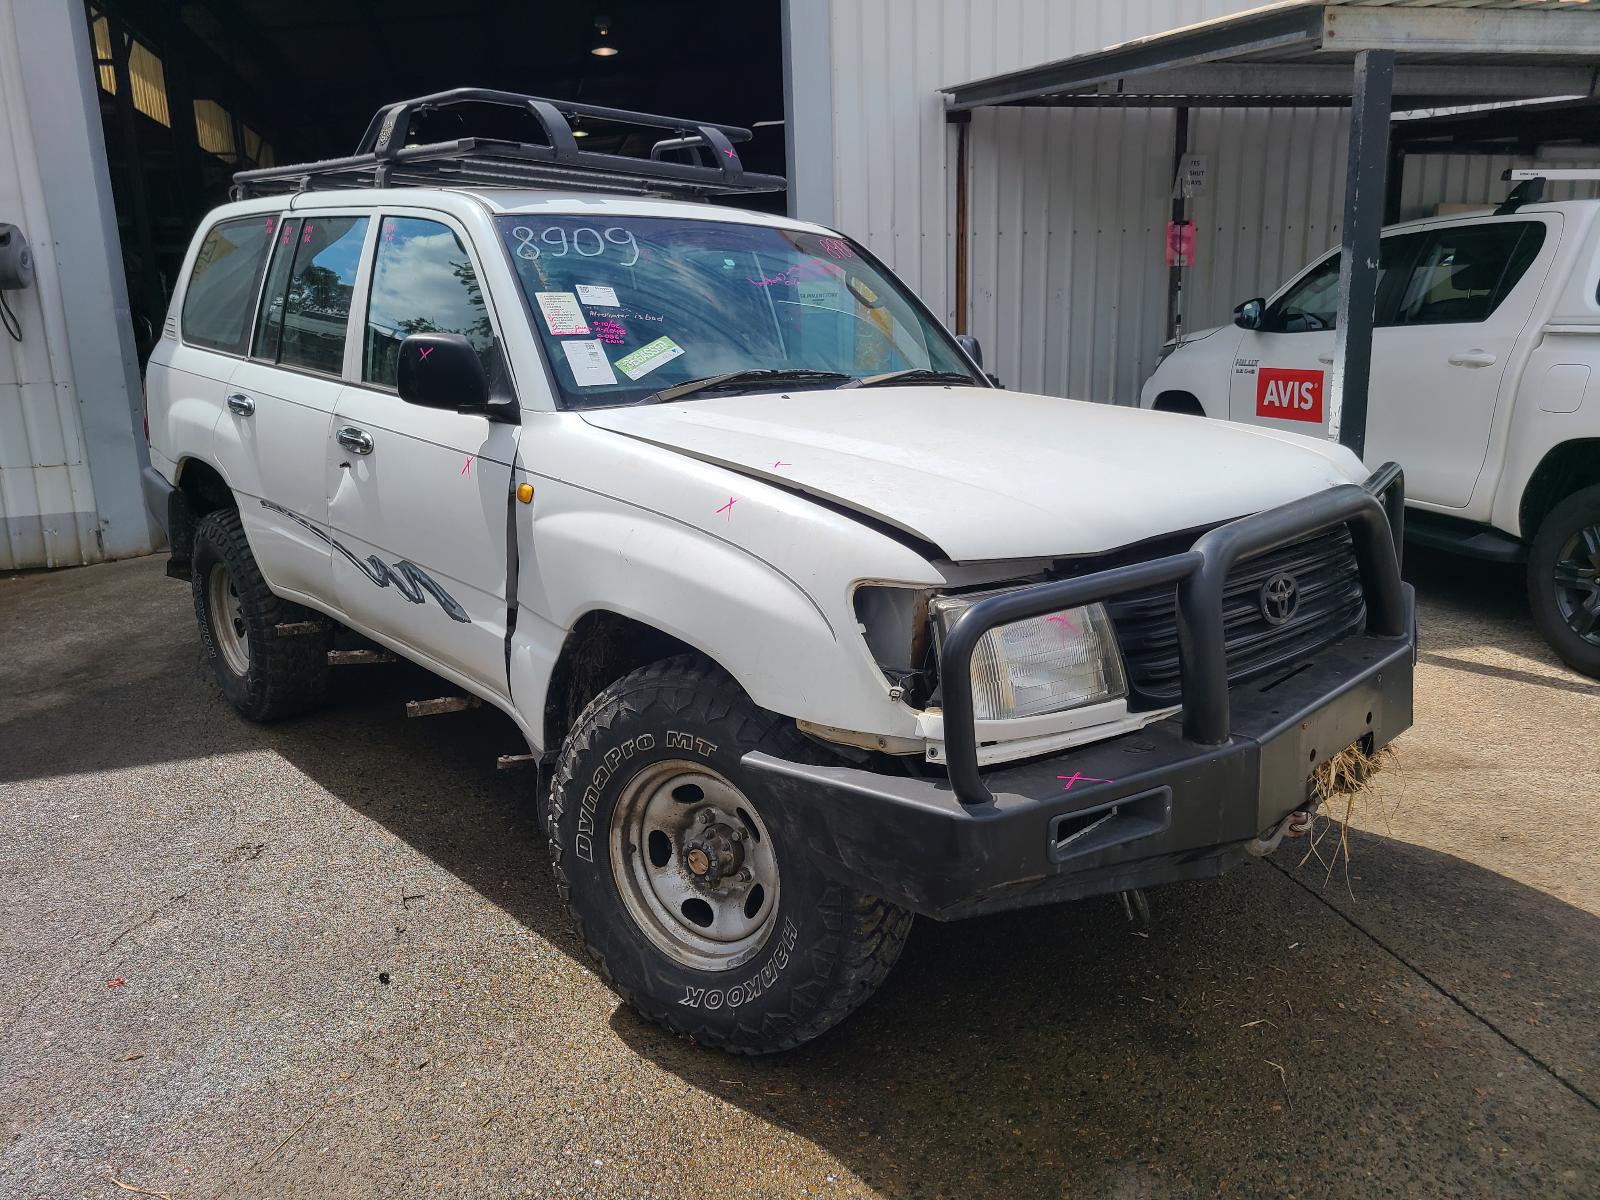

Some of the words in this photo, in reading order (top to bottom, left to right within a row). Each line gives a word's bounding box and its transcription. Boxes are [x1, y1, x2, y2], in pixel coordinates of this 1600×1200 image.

[512, 226, 640, 267] 8909
[634, 312, 643, 320] is
[645, 313, 664, 323] bad
[1263, 379, 1314, 411] AVIS
[666, 730, 719, 757] MT
